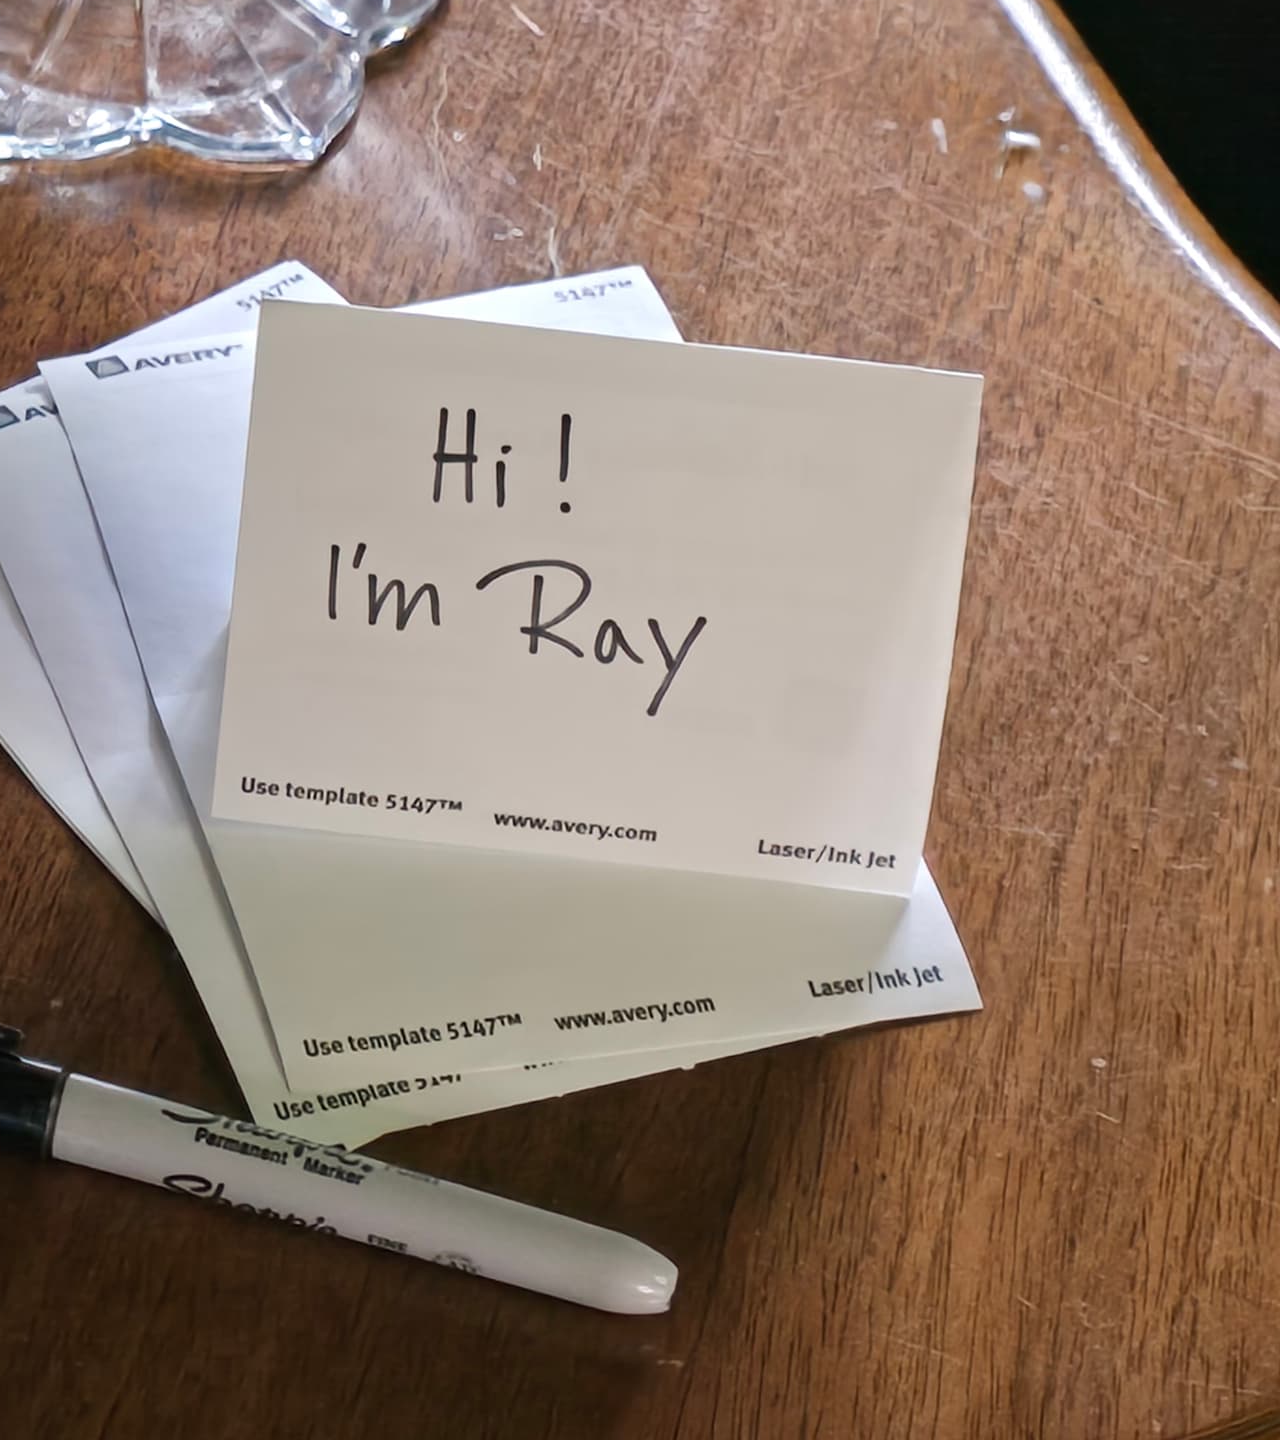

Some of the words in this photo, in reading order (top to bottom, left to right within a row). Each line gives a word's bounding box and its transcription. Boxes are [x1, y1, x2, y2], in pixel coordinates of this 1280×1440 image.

[328, 542, 440, 631] I'm
[476, 559, 707, 716] Ray
[240, 777, 280, 798] Use
[286, 781, 380, 810] template
[494, 810, 658, 844] www.avery.com
[866, 850, 897, 871] Jet
[303, 1036, 344, 1060] Use
[347, 1025, 442, 1056] template
[554, 994, 717, 1033] www.avery.com
[913, 963, 945, 990] Jet
[273, 1097, 315, 1122] Use
[317, 1077, 411, 1112] template
[194, 1126, 289, 1166] Permanent
[303, 1157, 366, 1186] Marker
